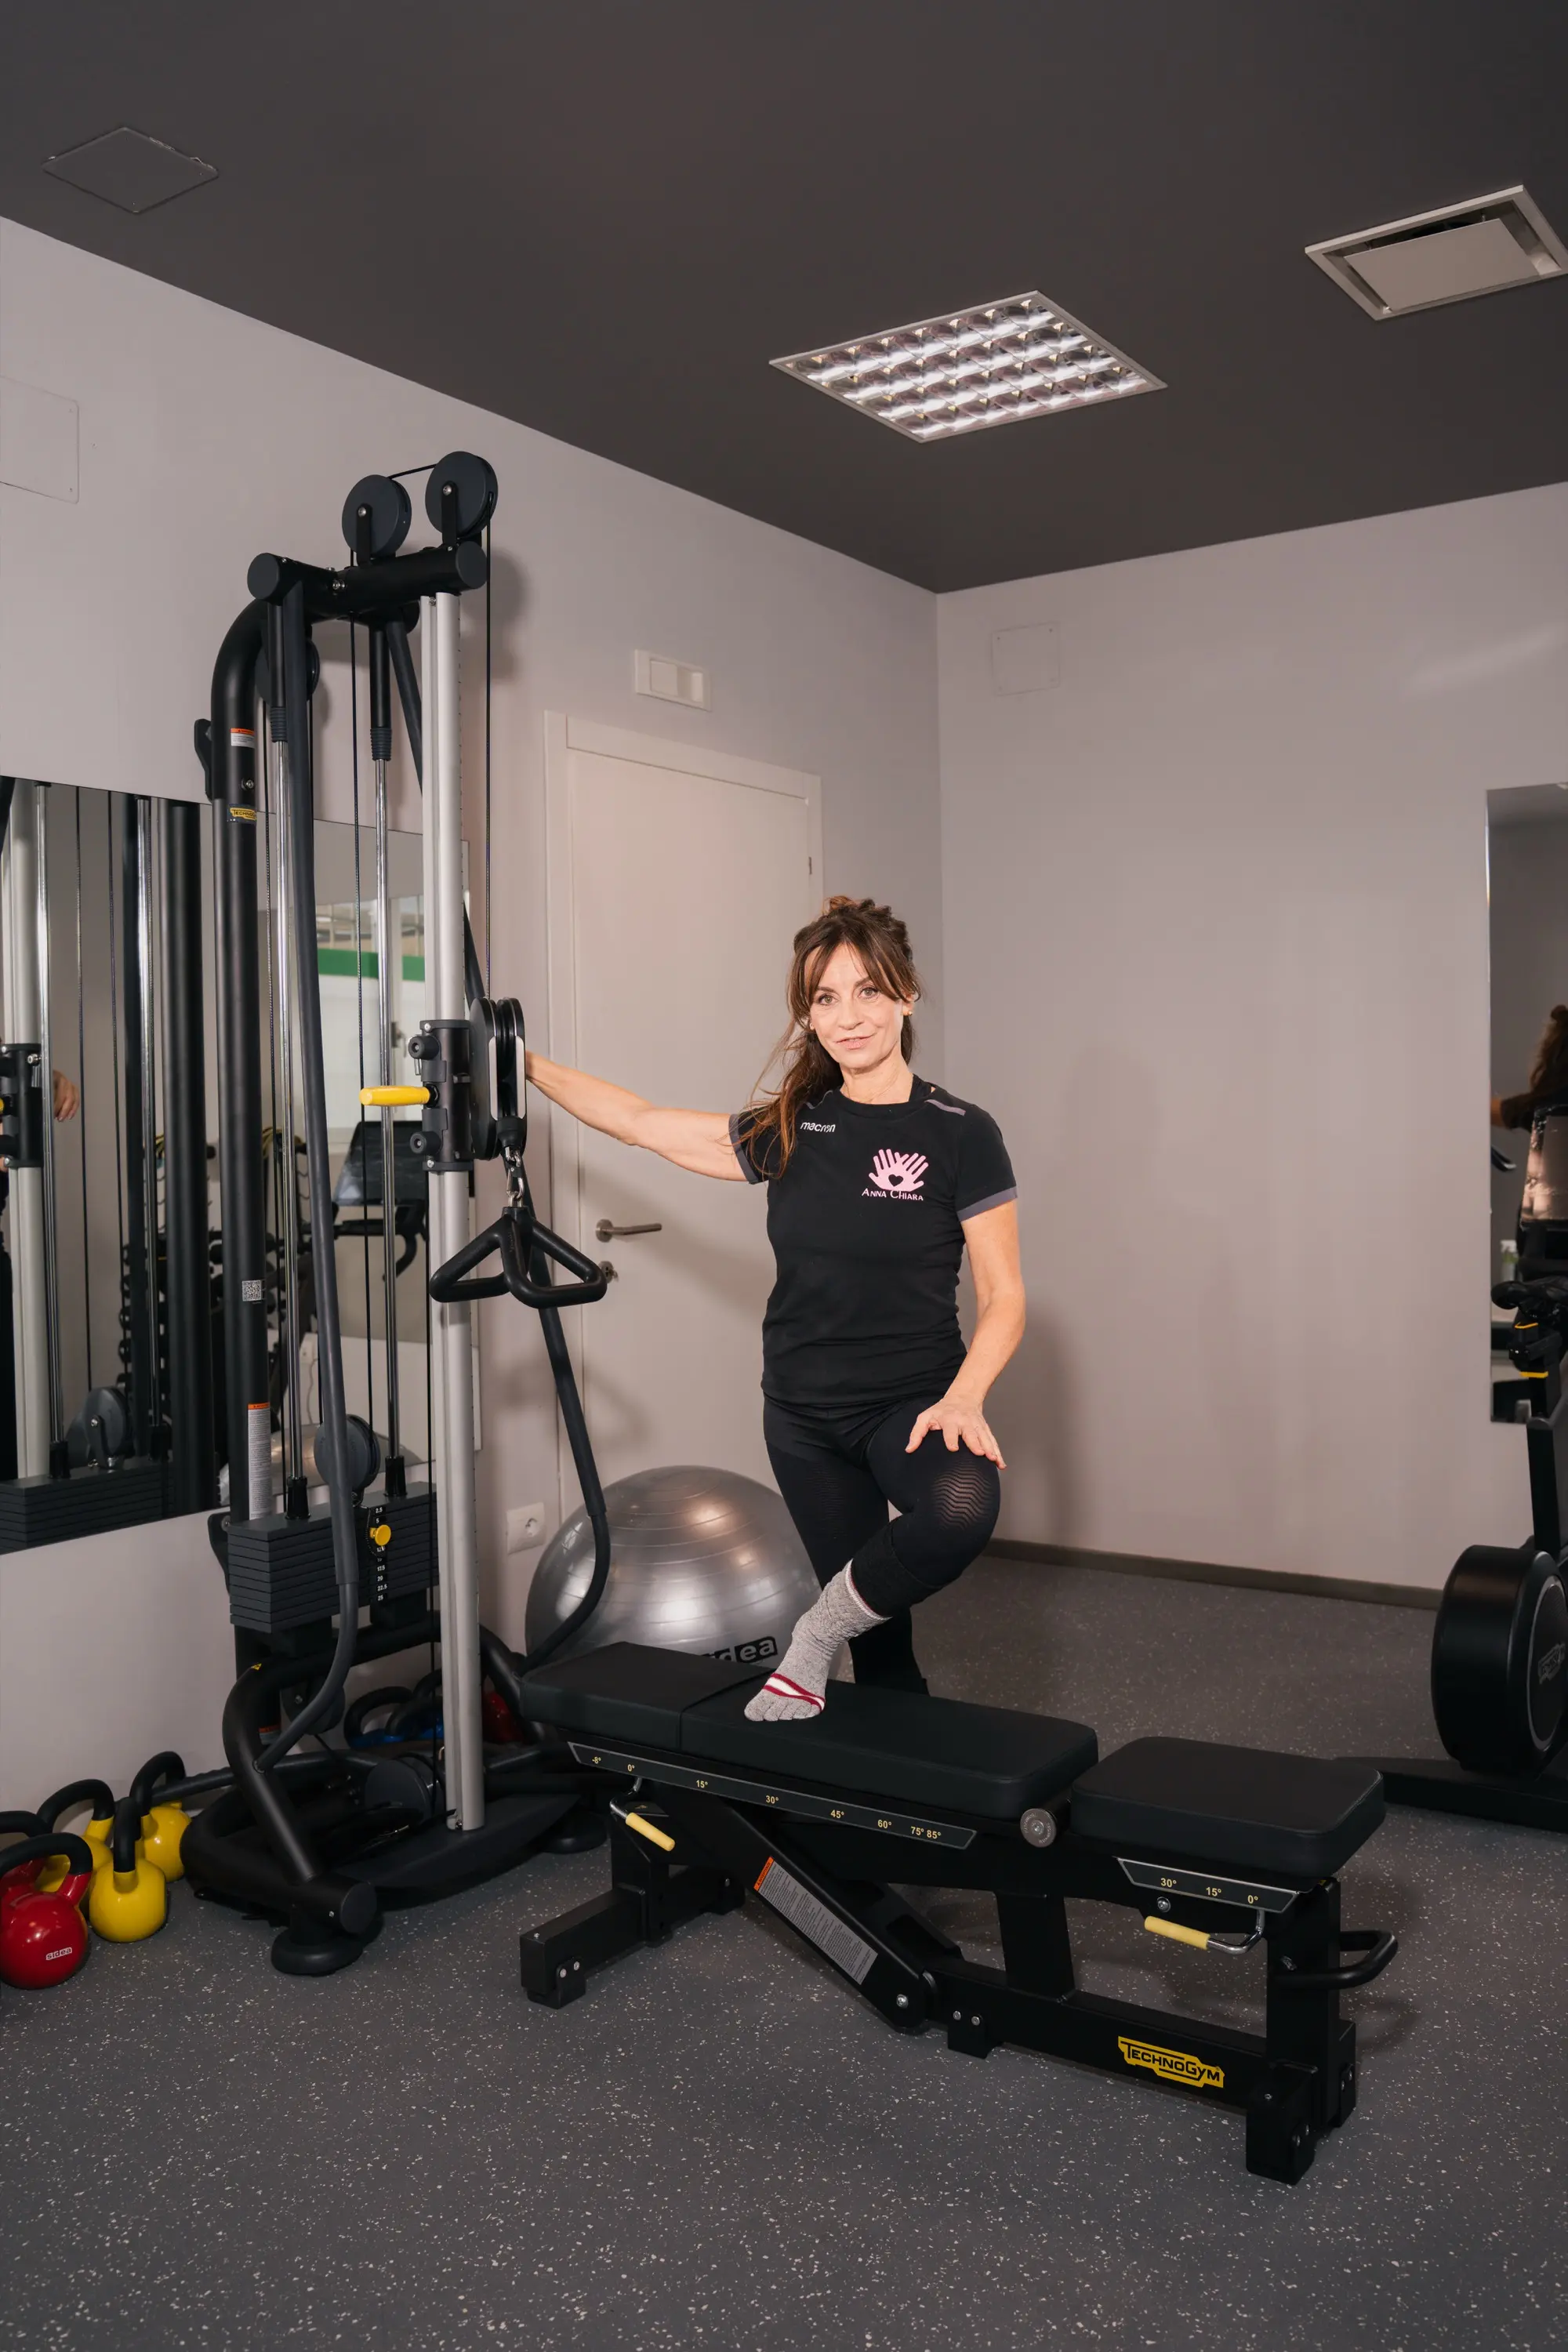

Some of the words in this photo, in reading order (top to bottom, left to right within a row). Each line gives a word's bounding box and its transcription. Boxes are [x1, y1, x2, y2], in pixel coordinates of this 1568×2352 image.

[862, 1188, 887, 1198] ANNA
[890, 1190, 924, 1201] CHIARA
[709, 1639, 775, 1662] dea
[696, 1780, 708, 1788] 15°
[766, 1795, 779, 1804] 30°
[830, 1809, 844, 1819] 45°
[877, 1820, 892, 1829] 60°
[910, 1826, 924, 1836] 75°
[927, 1830, 942, 1839] 85°
[1160, 1878, 1177, 1888] 30°
[1206, 1887, 1221, 1896] 15°
[1247, 1894, 1258, 1904] 0°
[47, 1947, 71, 1959] sidea
